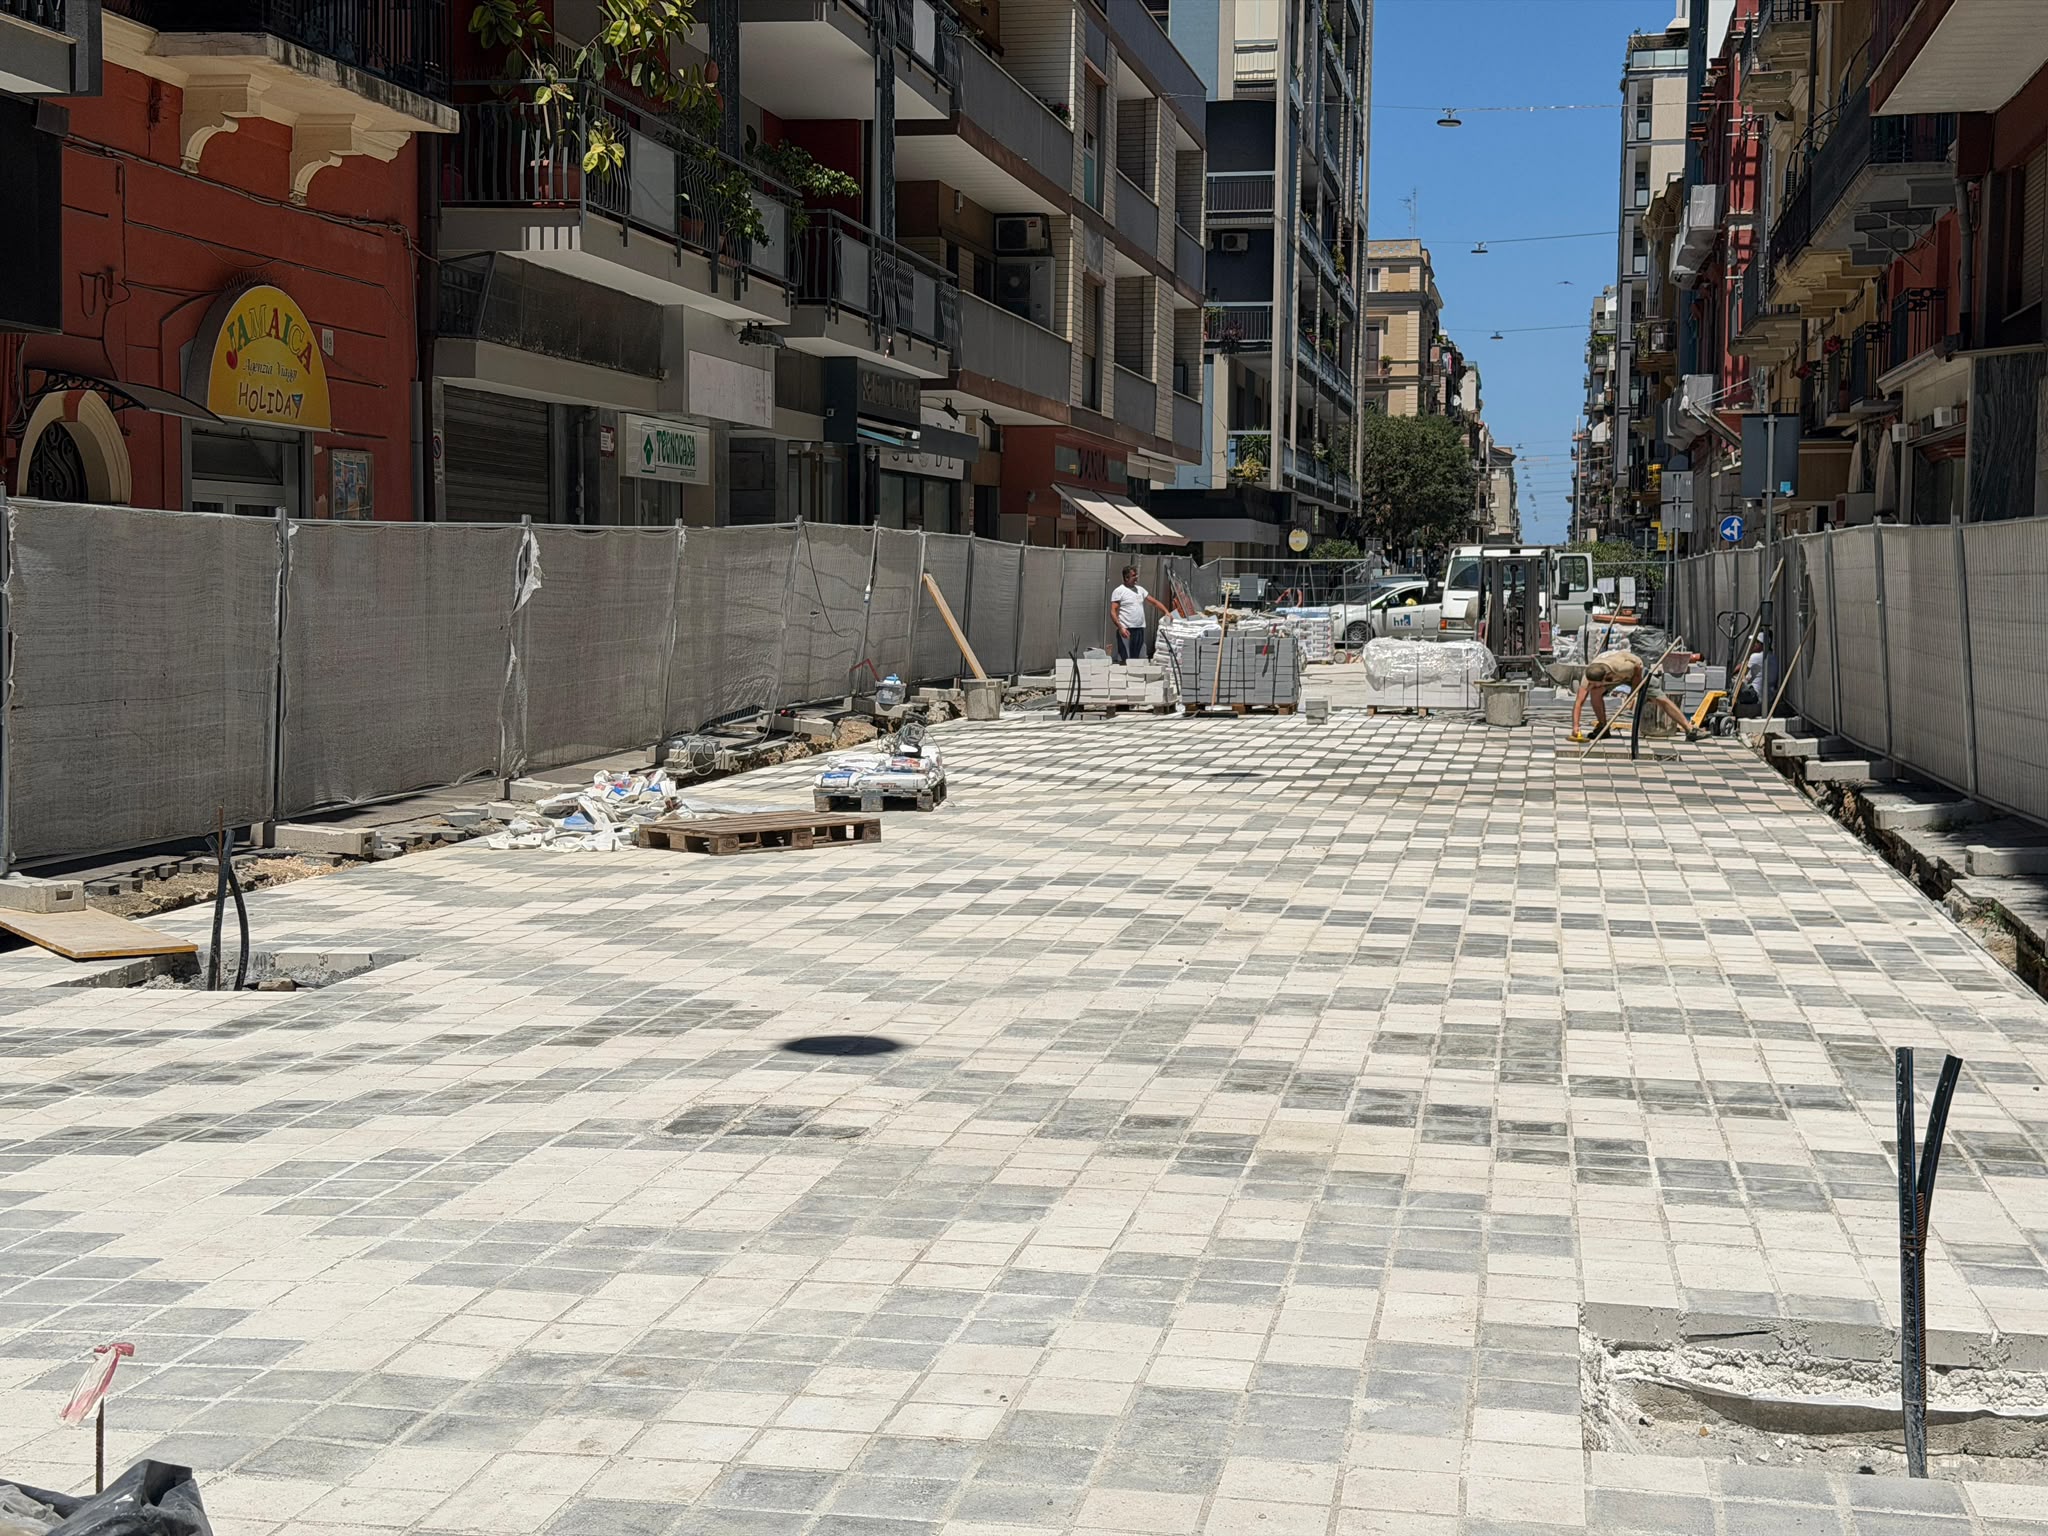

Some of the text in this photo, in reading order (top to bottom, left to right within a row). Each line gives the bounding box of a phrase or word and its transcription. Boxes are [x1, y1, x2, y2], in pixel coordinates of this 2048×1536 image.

[226, 304, 313, 375] JAMAICA
[243, 358, 273, 376] Agenzia
[238, 382, 304, 419] HOLIDAY
[656, 430, 696, 467] TECNOCASA
